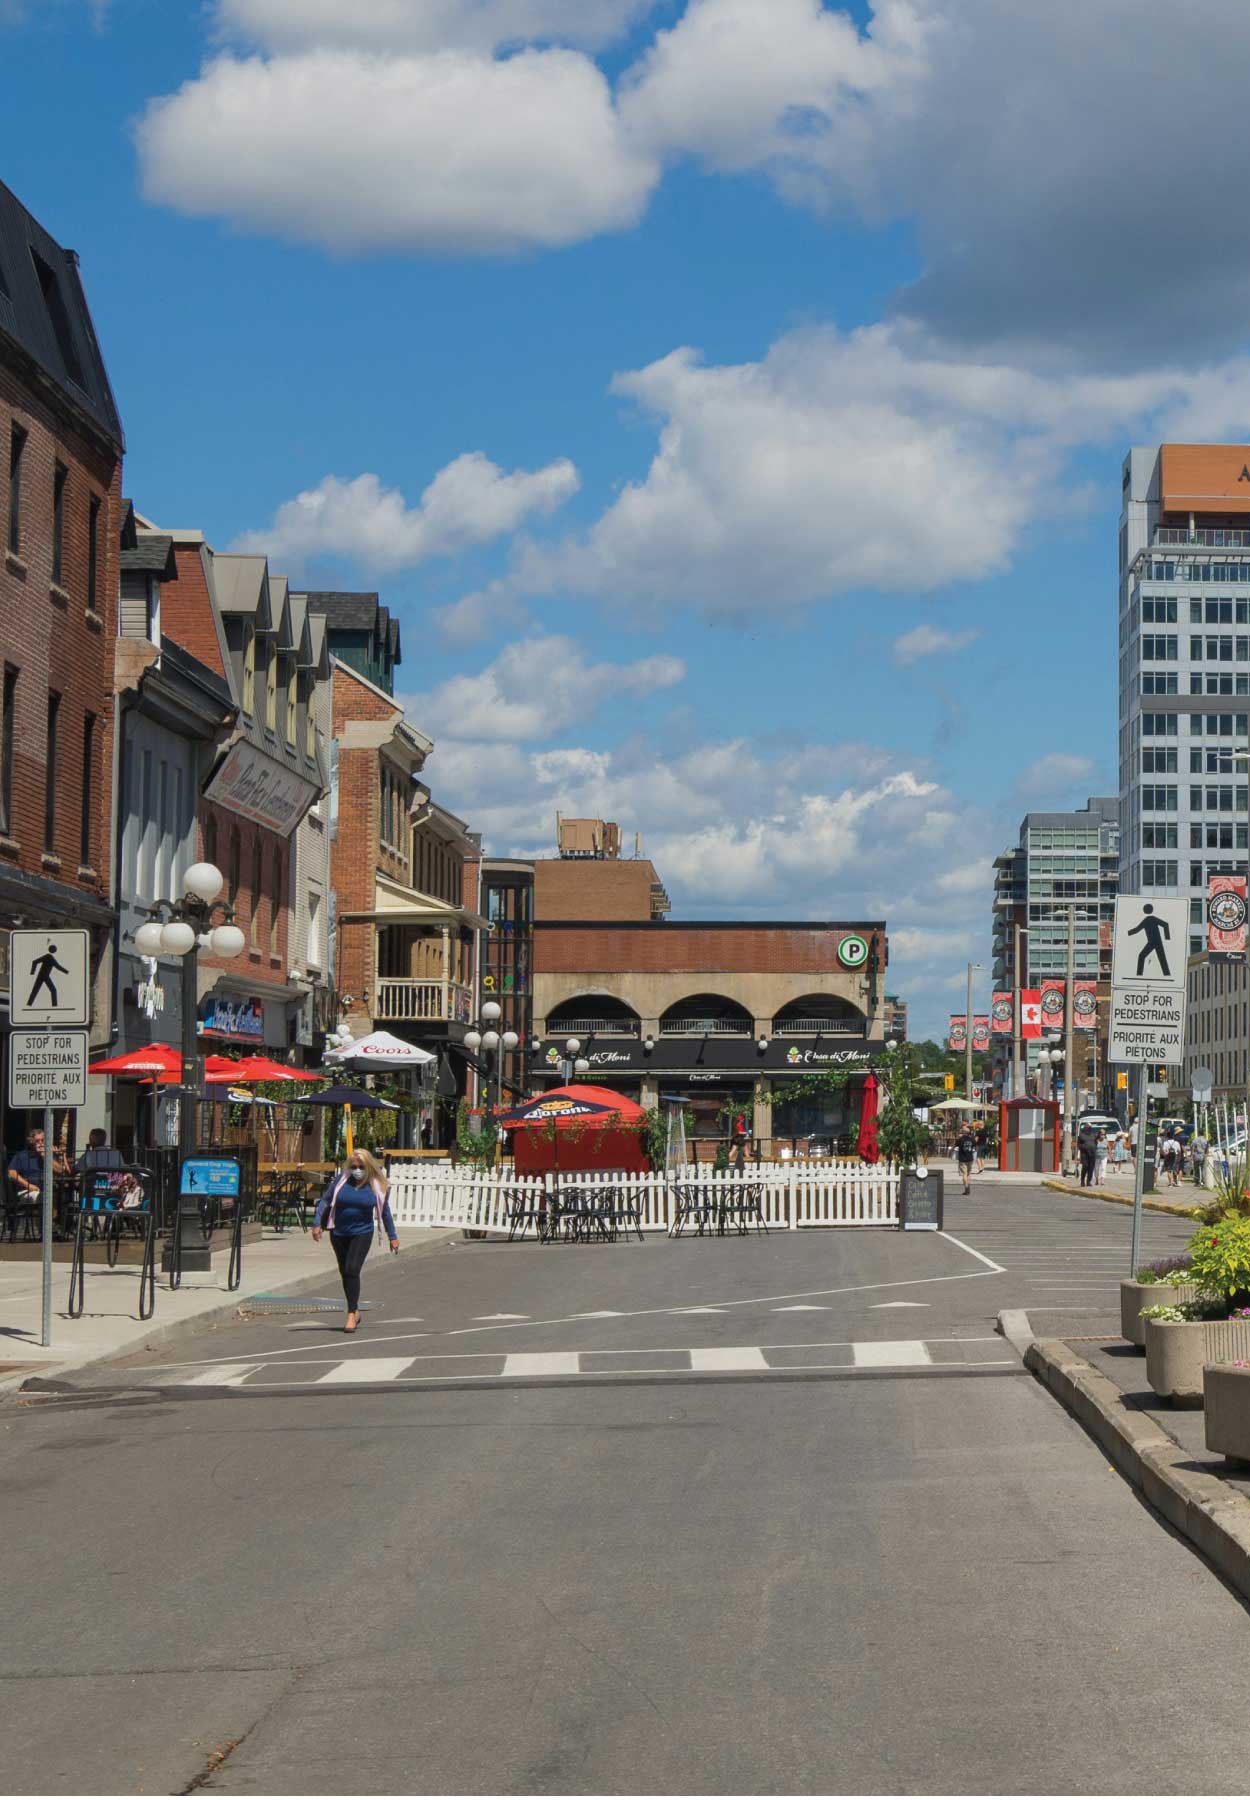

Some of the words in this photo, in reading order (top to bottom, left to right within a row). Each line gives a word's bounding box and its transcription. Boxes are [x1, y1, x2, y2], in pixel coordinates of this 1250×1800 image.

[849, 943, 860, 959] P
[1123, 994, 1149, 1006] STOP
[1153, 995, 1172, 1007] FOR
[1114, 1008, 1181, 1021] PEDESTRIANS
[25, 1037, 49, 1049] STOP
[54, 1037, 72, 1049] FOR
[1159, 1033, 1179, 1045] AUX
[361, 1045, 411, 1054] Coors
[17, 1053, 80, 1065] PEDESTRIANS
[62, 1073, 81, 1084] AUX
